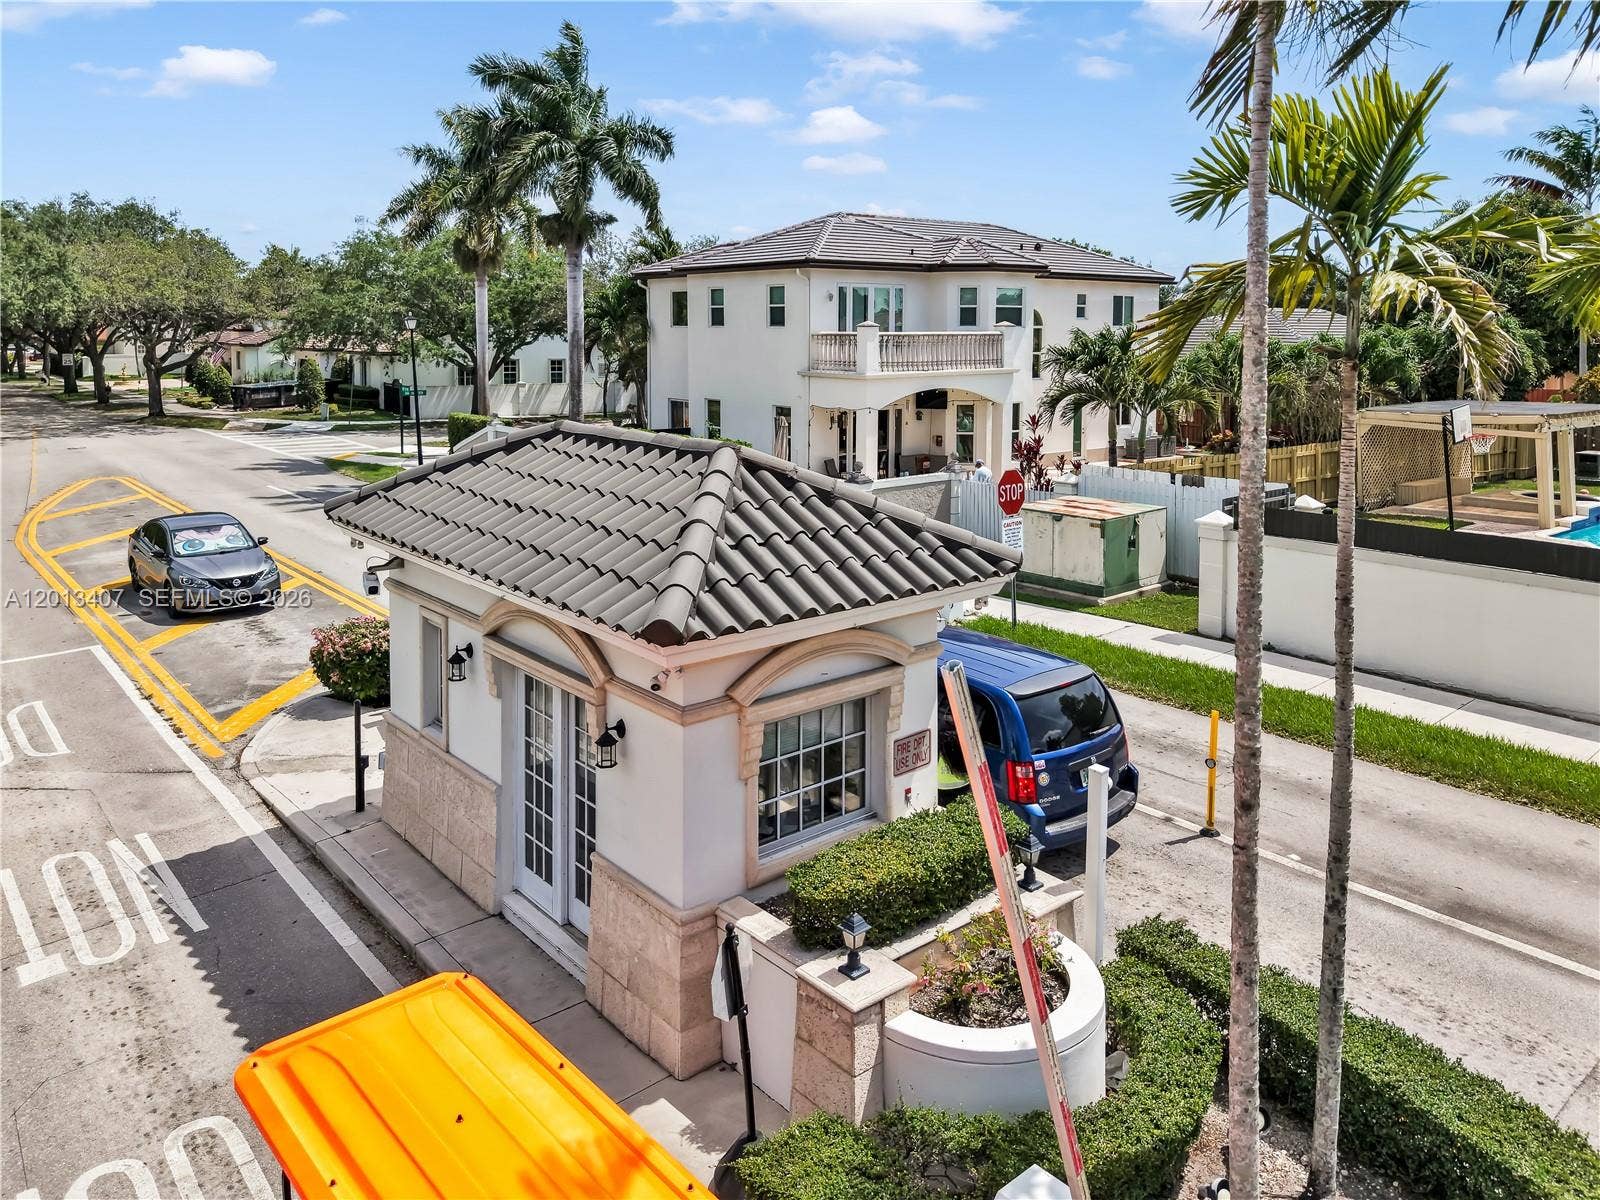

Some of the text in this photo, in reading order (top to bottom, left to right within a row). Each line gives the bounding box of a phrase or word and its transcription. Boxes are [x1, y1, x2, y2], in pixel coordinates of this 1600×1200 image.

[1000, 483, 1023, 502] STOP
[1003, 520, 1022, 528] CAUTION
[896, 747, 930, 770] USE ONLY
[897, 741, 911, 757] FIRE
[0, 832, 209, 987] NOT
